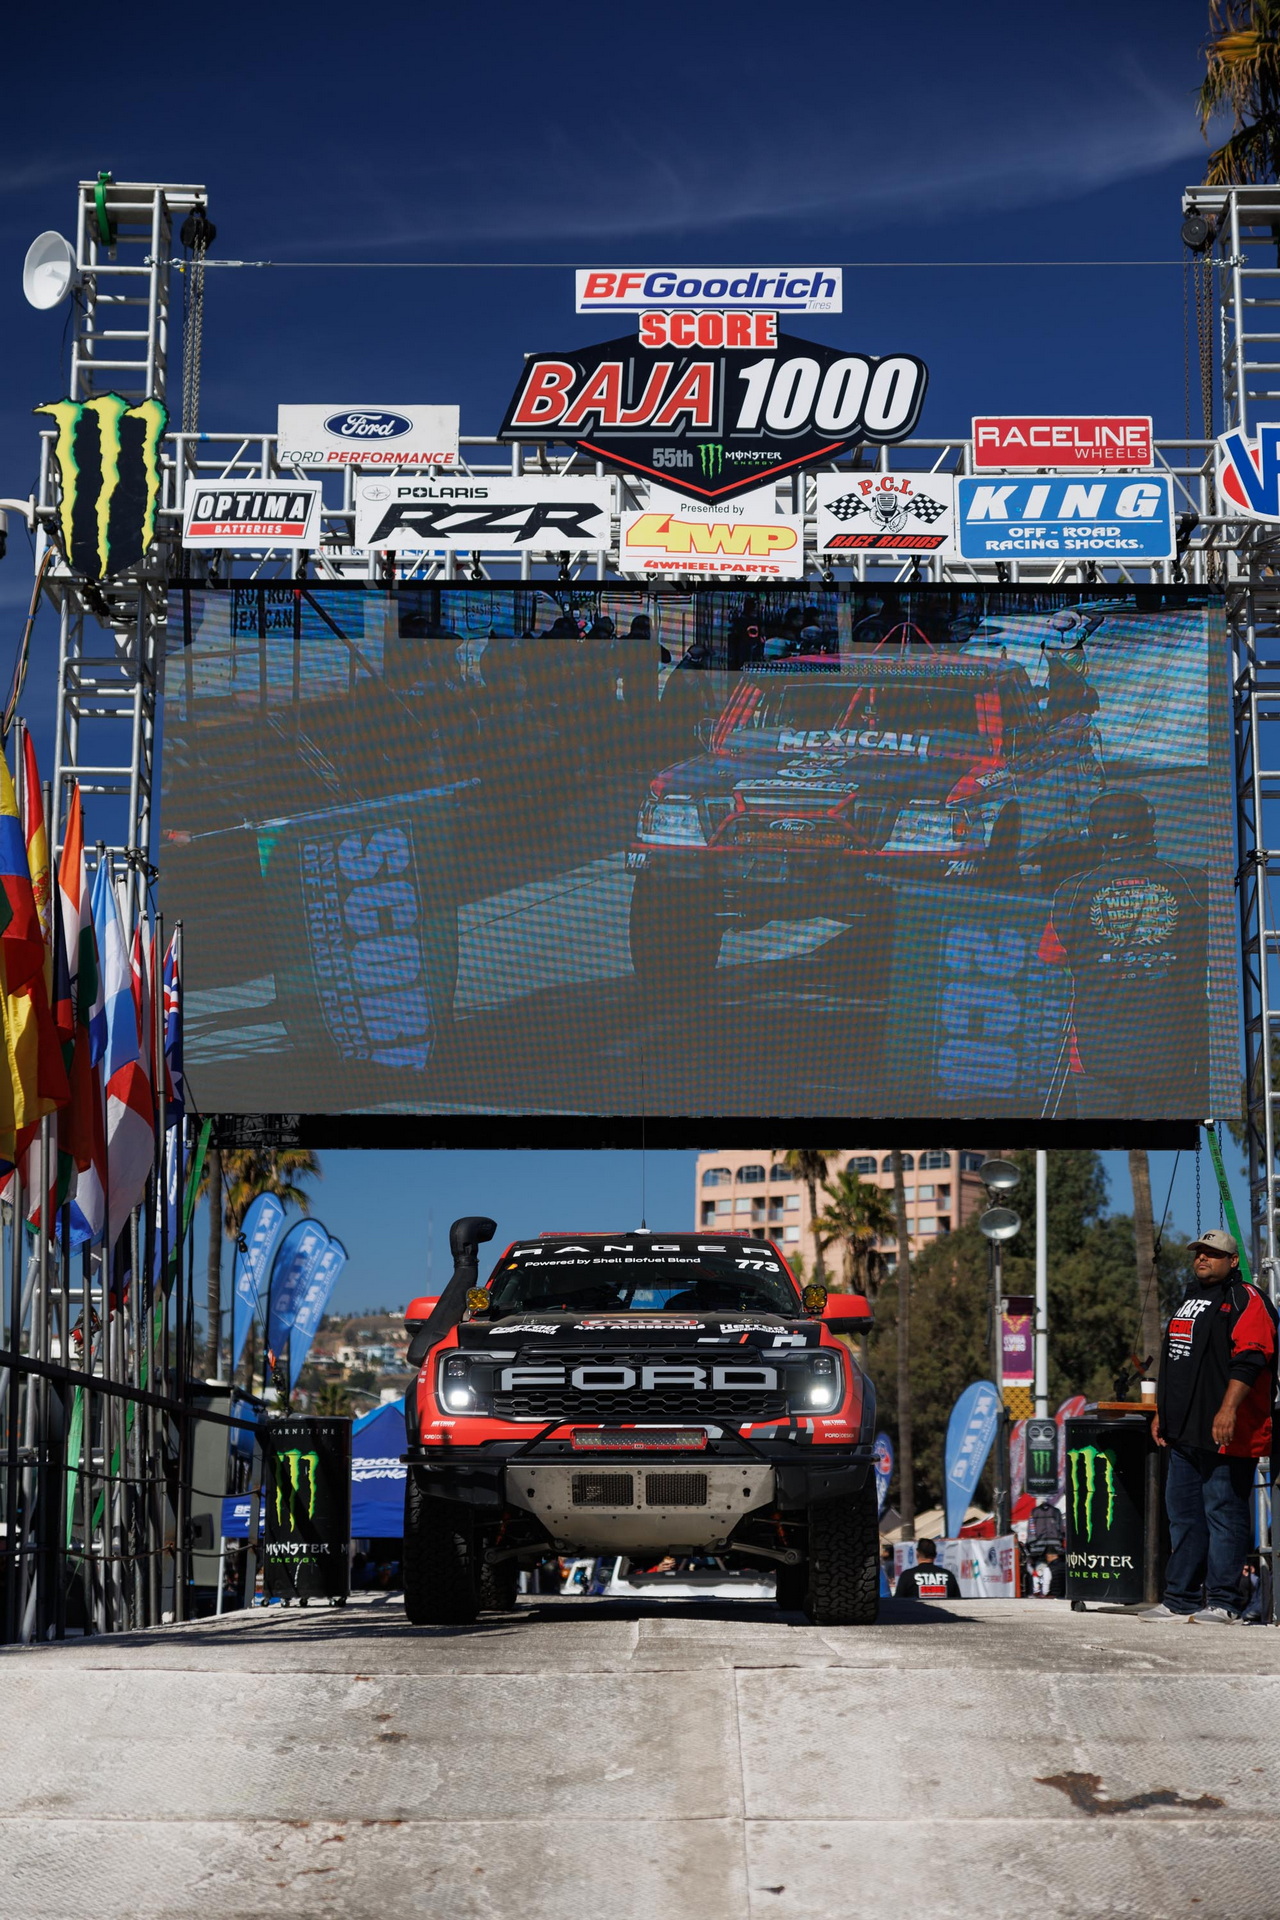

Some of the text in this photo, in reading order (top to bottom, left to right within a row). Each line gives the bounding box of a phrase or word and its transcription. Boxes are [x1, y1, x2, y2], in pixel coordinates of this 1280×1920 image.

[582, 271, 836, 299] BFGoodrich
[807, 299, 833, 310] Tires
[640, 312, 778, 348] SCORE
[511, 357, 918, 430] BAJA 1000
[341, 411, 396, 438] Ford
[978, 425, 1147, 447] RACELINE
[280, 451, 454, 464] FORD PERFORMANCE
[652, 448, 693, 468] 55th
[725, 450, 782, 461] MONSTER
[1075, 448, 1147, 459] WHEELS
[398, 486, 489, 499] POLARIS
[967, 483, 1162, 520] KING
[198, 494, 304, 520] OPTIMA
[680, 503, 745, 516] Presented by
[214, 524, 283, 536] BATTERIES
[369, 503, 604, 544] RZR
[625, 513, 799, 556] 4WP
[829, 534, 943, 549] RACE RADIOS
[985, 538, 1058, 551] RACING
[777, 729, 930, 758] MEXICALI
[734, 778, 859, 791] BFGoodrich
[319, 841, 370, 1061] INTERNATIONA
[238, 1208, 275, 1293] KING
[524, 1258, 574, 1268] Powered
[576, 1258, 591, 1268] by
[735, 1258, 780, 1273] 773
[295, 1251, 335, 1325] KING
[1174, 1298, 1212, 1319] TAFF
[501, 1365, 778, 1391] FORD
[953, 1395, 994, 1480] KING
[265, 1541, 331, 1557] MONSTER
[914, 1572, 948, 1586] STAFF
[1069, 1571, 1122, 1580] ENERGY
